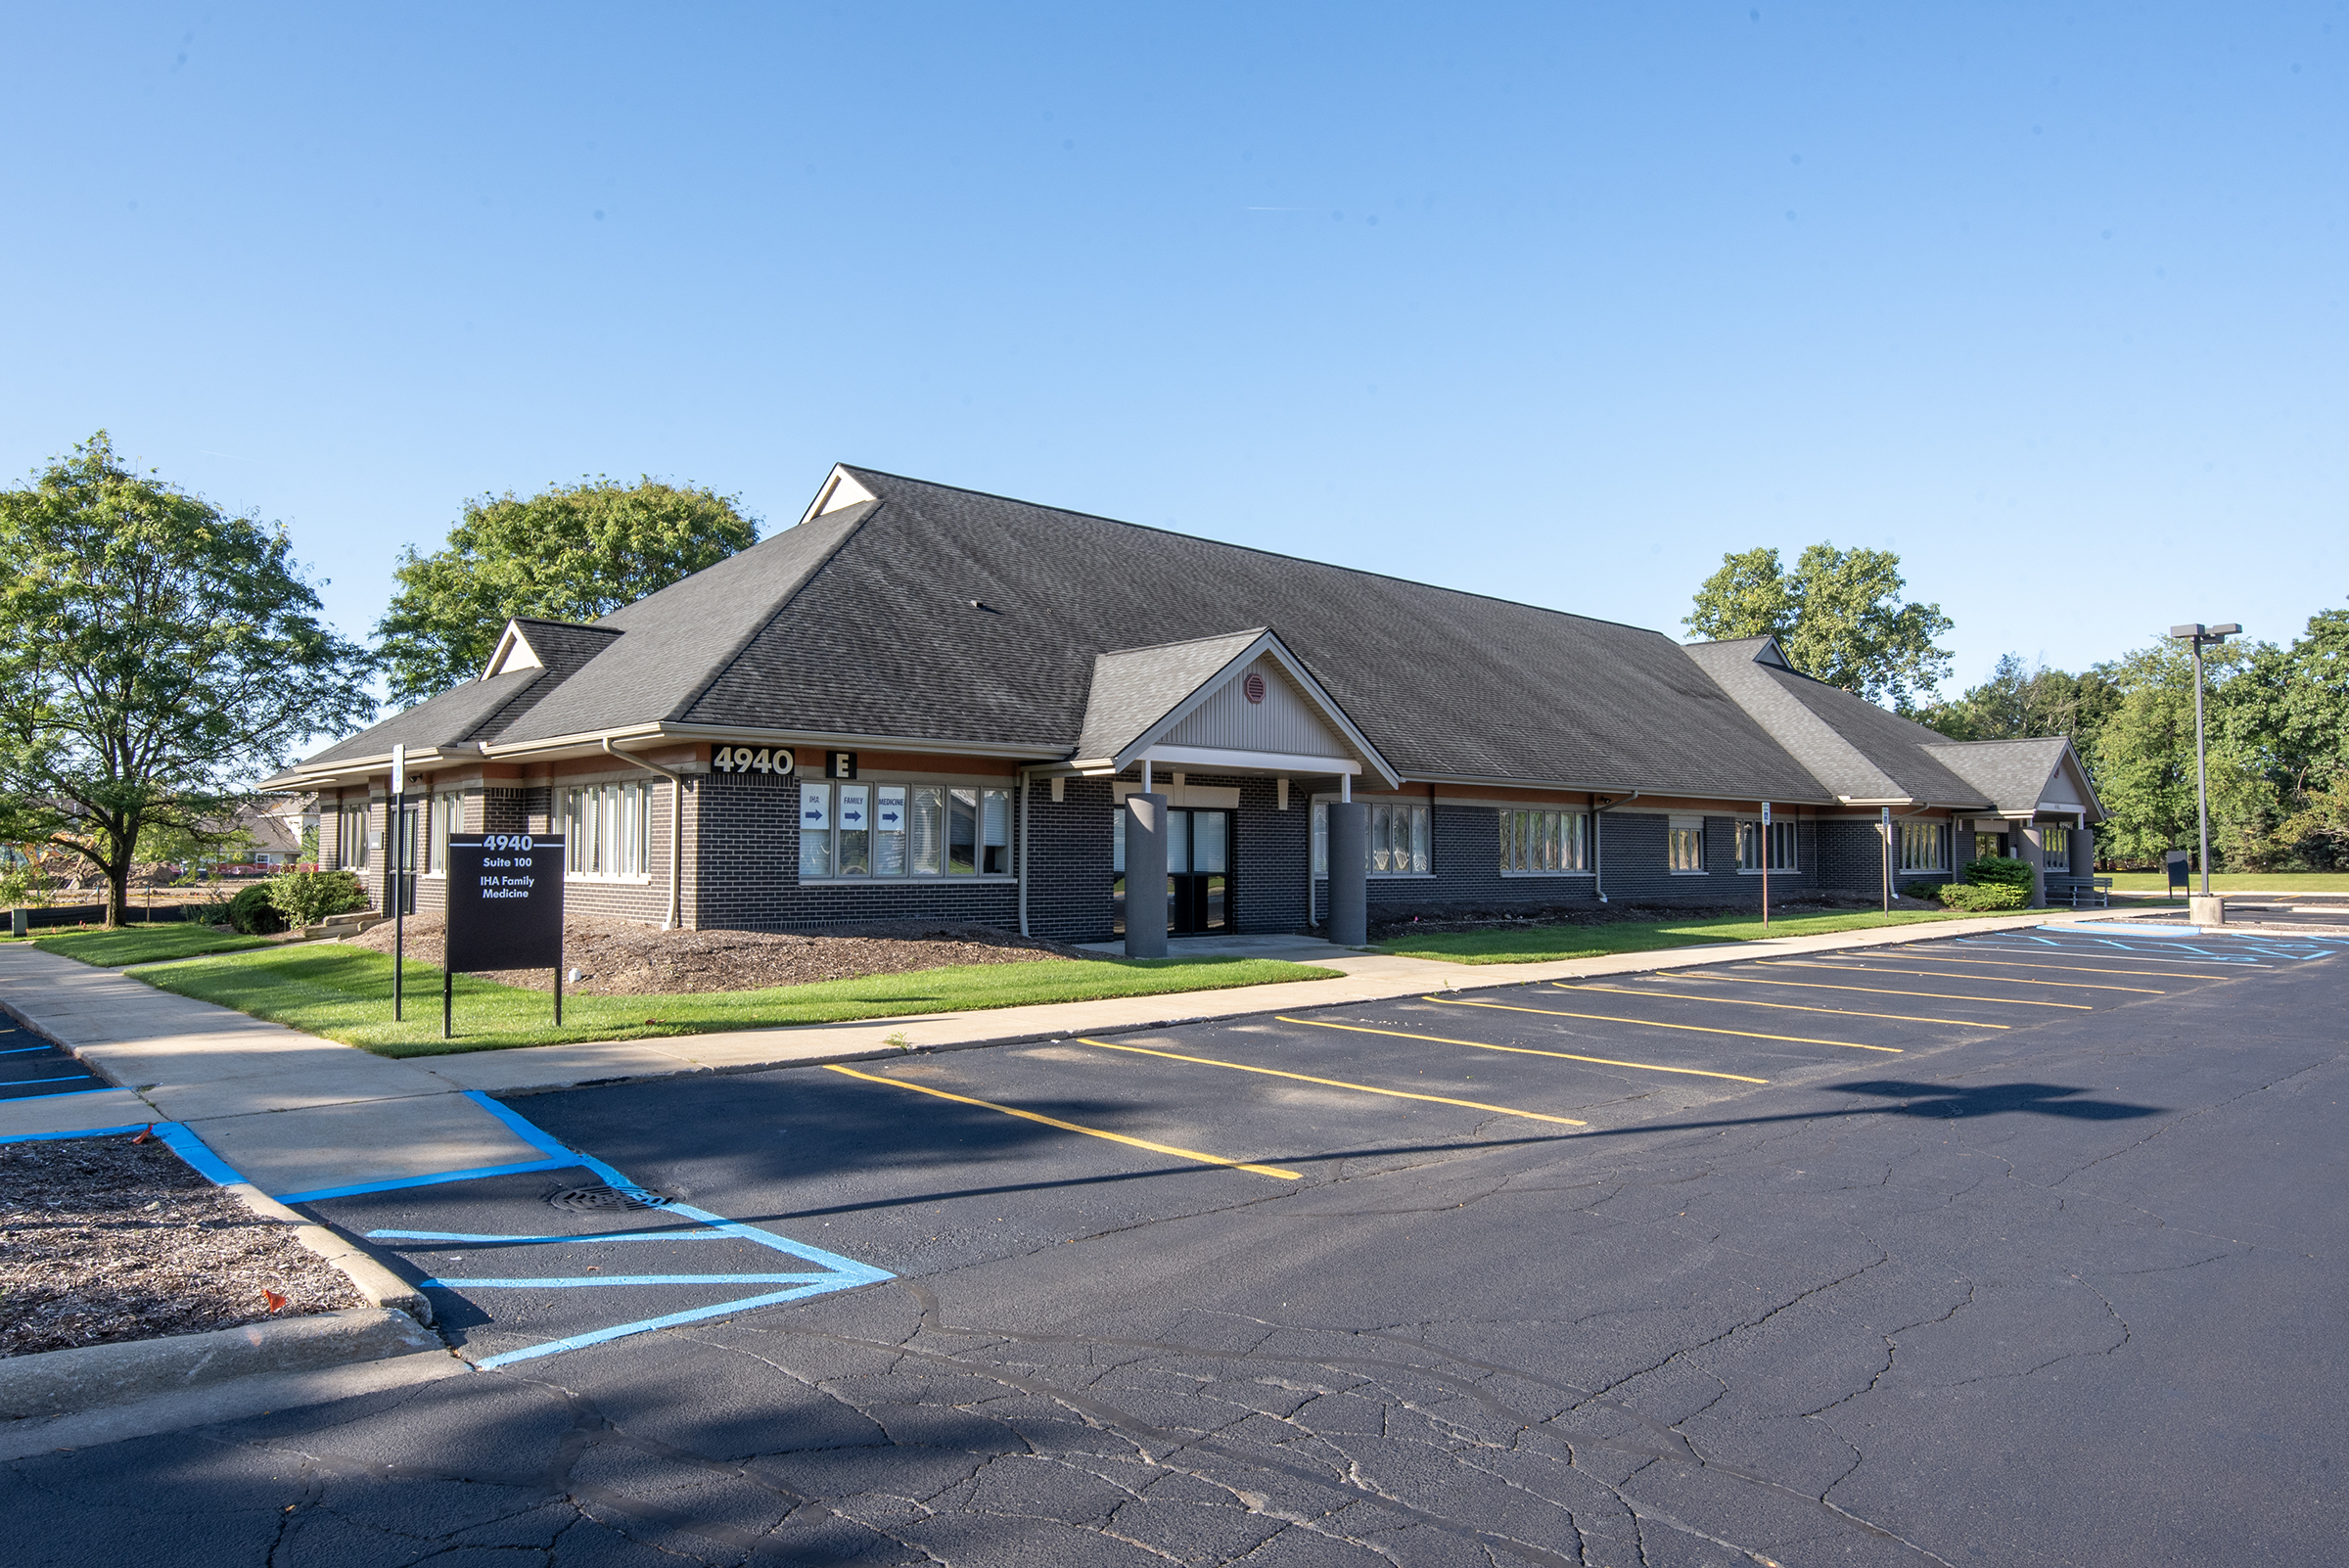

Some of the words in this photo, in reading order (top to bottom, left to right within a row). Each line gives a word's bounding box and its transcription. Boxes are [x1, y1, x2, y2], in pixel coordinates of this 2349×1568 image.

[714, 747, 794, 775] 4940
[836, 753, 850, 778] E
[808, 795, 820, 804] IHA
[843, 796, 864, 805] FAMILY
[878, 798, 903, 807] MEDICINE
[483, 835, 533, 852] 4940
[483, 857, 511, 867] Suite
[514, 857, 532, 867] 100
[480, 876, 499, 886] IHA
[501, 876, 534, 888] Family
[483, 889, 530, 899] Medicine
